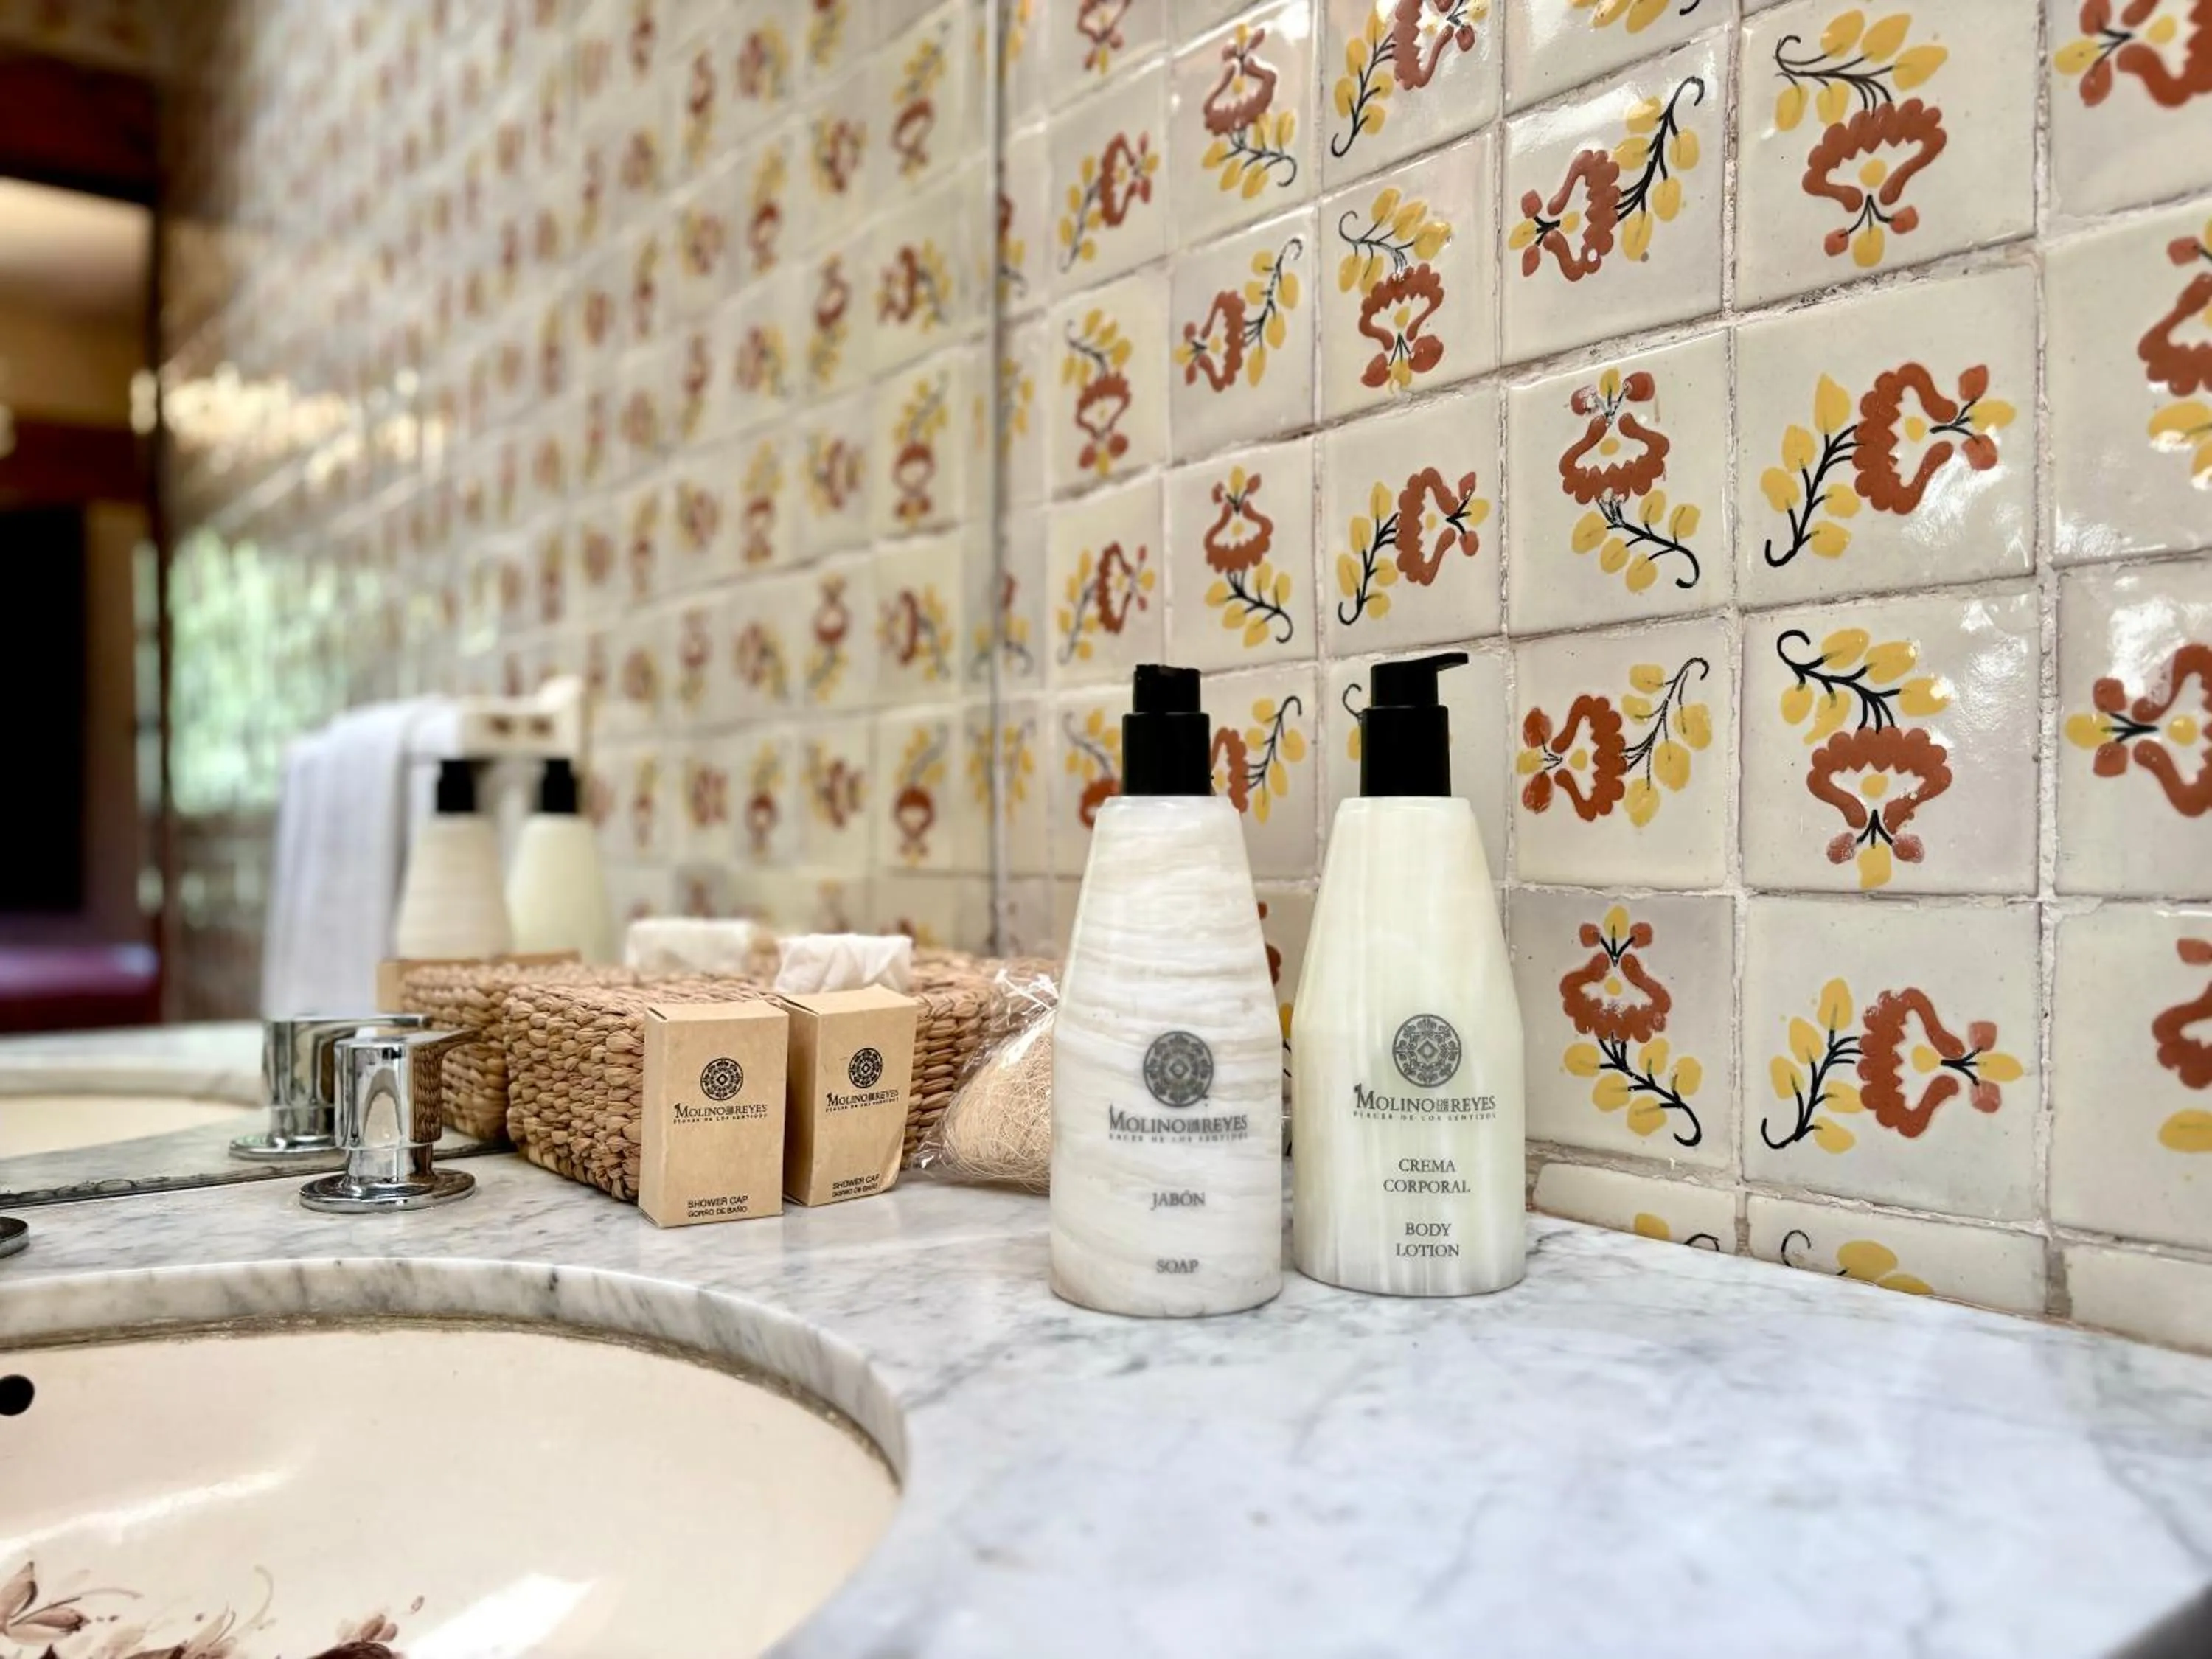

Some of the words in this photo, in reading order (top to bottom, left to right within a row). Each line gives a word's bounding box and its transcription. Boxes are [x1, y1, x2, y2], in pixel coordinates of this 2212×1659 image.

[735, 1104, 768, 1114] REYES
[1450, 1096, 1497, 1113] REYES
[1202, 1115, 1248, 1134] REYES
[1398, 1158, 1455, 1173] CREMA
[1382, 1179, 1471, 1194] CORPORAL
[687, 1197, 728, 1209] SHOWER
[729, 1195, 748, 1205] CAP
[1150, 1189, 1206, 1211] JABÓN
[716, 1207, 726, 1215] DE
[1405, 1222, 1452, 1237] BODY
[1395, 1243, 1460, 1257] LOTION
[1155, 1258, 1200, 1274] SOAP
